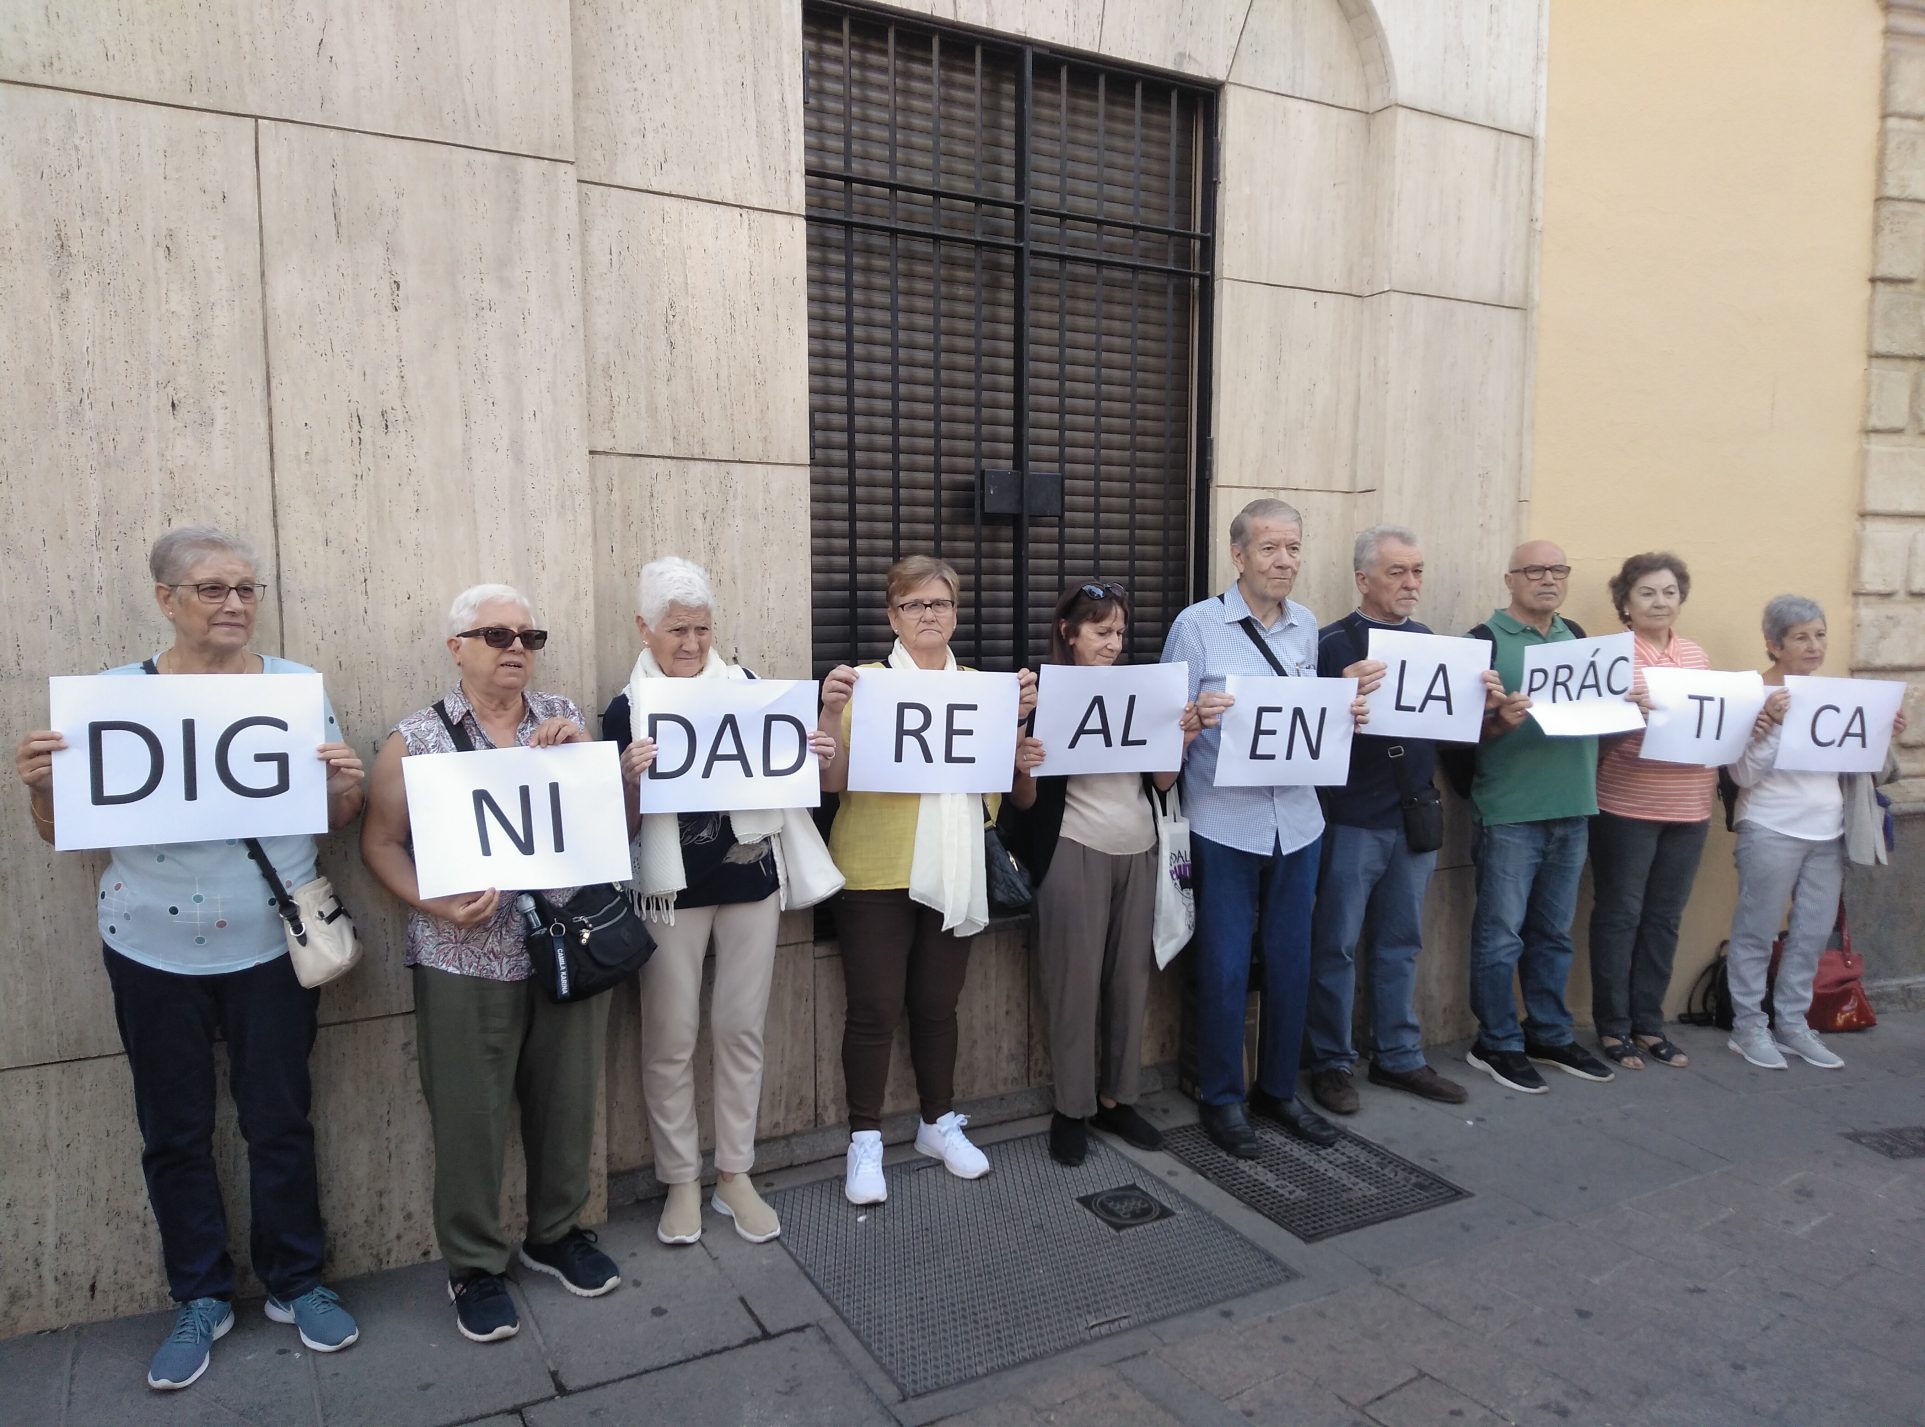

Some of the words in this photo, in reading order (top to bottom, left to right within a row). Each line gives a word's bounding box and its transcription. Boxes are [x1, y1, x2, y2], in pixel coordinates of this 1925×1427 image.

[1394, 659, 1454, 716] LA
[1527, 647, 1630, 704] PRÁC
[647, 713, 808, 780] DAD
[894, 702, 978, 764] RE
[1067, 694, 1148, 750] AL
[1248, 706, 1327, 761] EN
[1688, 695, 1726, 741] TI
[1810, 704, 1867, 749] CA
[88, 716, 290, 806] DIG
[472, 781, 565, 857] NI
